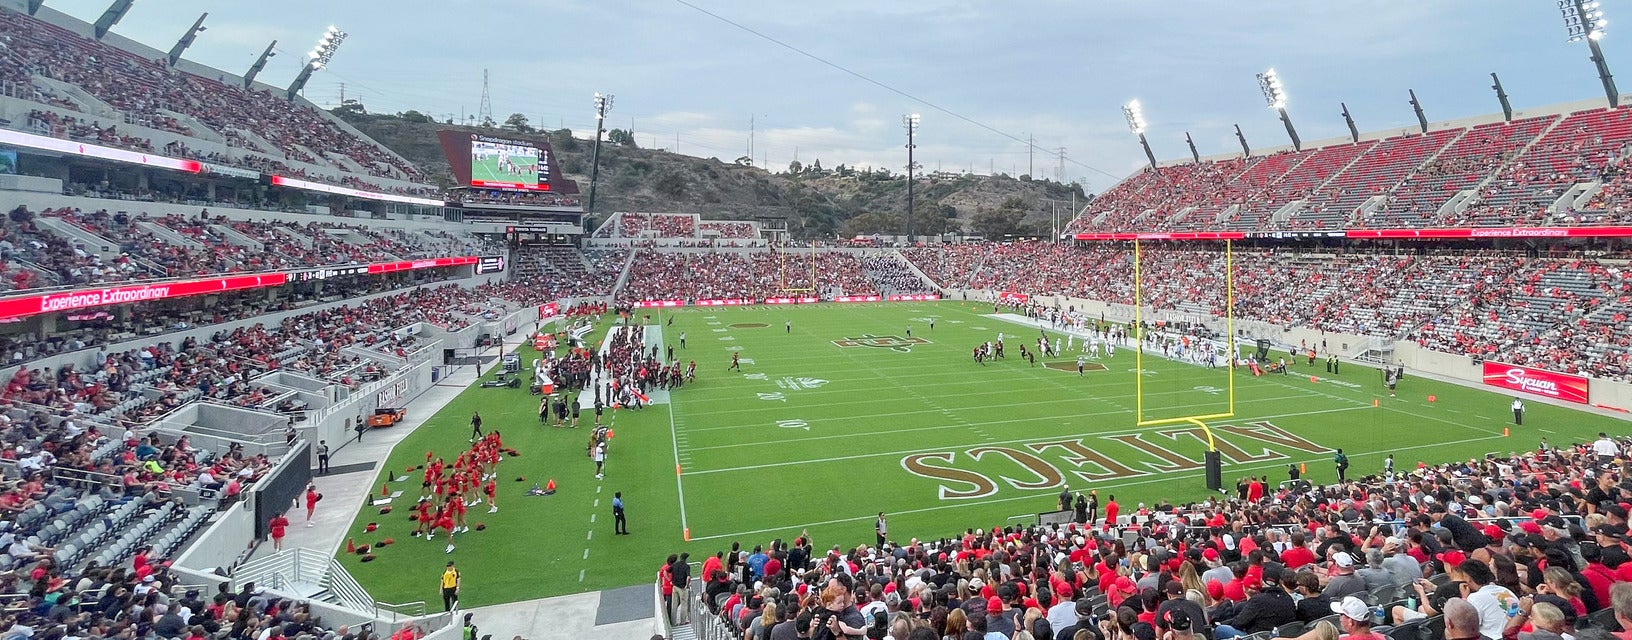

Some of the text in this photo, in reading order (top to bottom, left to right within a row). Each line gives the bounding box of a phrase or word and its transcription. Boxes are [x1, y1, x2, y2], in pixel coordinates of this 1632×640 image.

[479, 135, 512, 145] Snapdragon
[1471, 229, 1568, 237] Experience Extraordinary
[42, 286, 169, 310] Experience Extraordinary
[1506, 369, 1557, 389] Sycuan
[900, 421, 1337, 500] AZTECS
